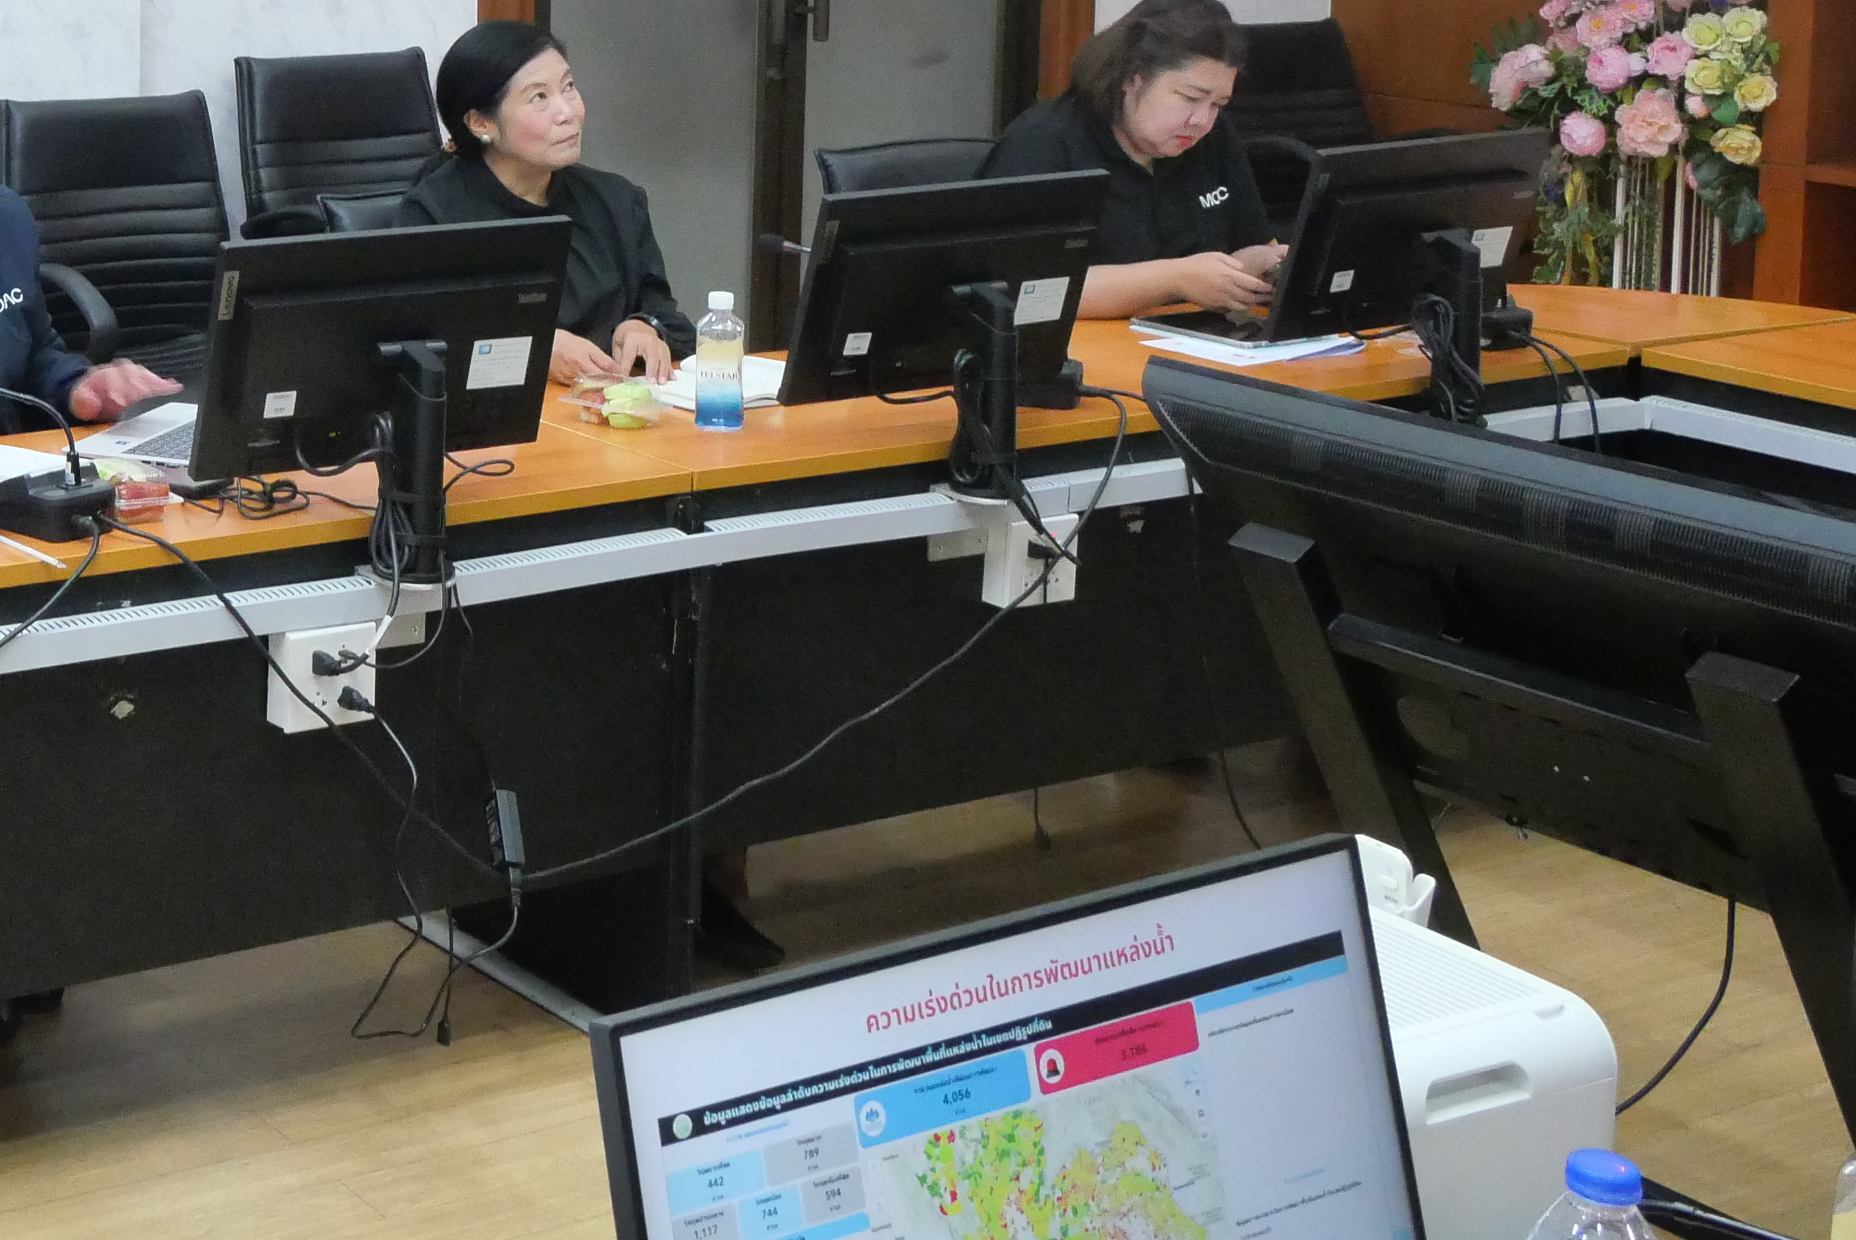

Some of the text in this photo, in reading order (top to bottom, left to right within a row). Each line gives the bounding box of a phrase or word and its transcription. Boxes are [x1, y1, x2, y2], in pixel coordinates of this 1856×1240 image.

[865, 922, 1176, 1034] ความเร่งด่วนในการพัฒนาแหล่งน้ำ
[942, 1086, 972, 1106] 4,056
[803, 1147, 820, 1161] 789
[707, 1175, 725, 1189] 442
[824, 1187, 842, 1201] 594
[761, 1206, 779, 1221] 744
